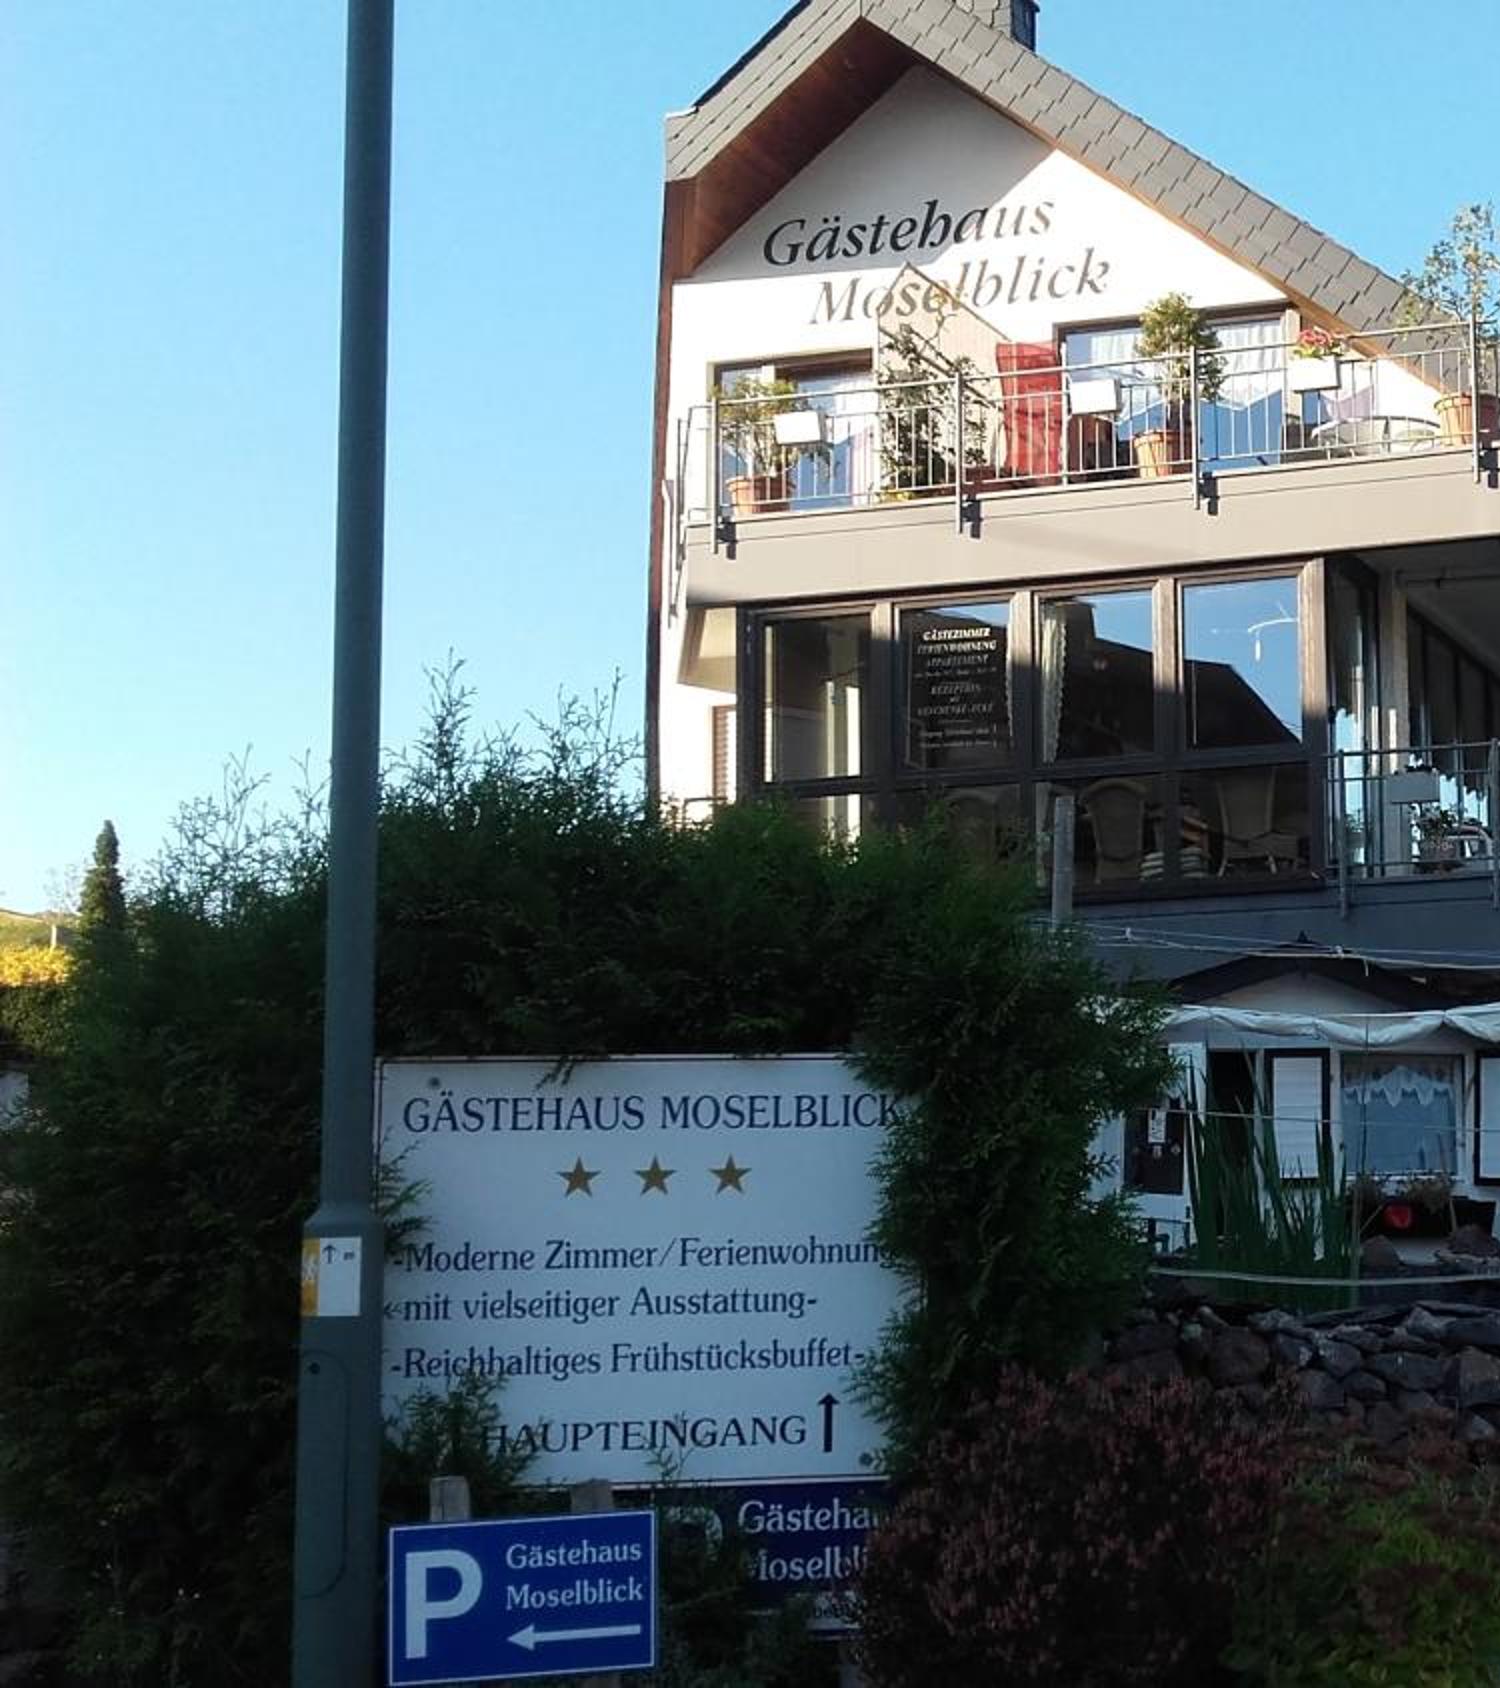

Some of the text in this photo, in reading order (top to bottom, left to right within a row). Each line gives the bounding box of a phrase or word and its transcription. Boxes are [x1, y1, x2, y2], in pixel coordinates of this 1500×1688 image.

[763, 200, 1055, 266] Gästehaus
[810, 248, 1110, 325] Moselblick
[403, 1092, 899, 1133] GÄSTEHAUS MOSELBLICK
[463, 1289, 619, 1325] vielseitiger
[629, 1286, 818, 1319] Ausstattung-
[391, 1336, 866, 1381] -Reichhaltiges Frühstücksbuffet-
[506, 1543, 642, 1568] Gästehaus
[404, 1548, 484, 1660] P
[506, 1577, 643, 1611] Moselblick
